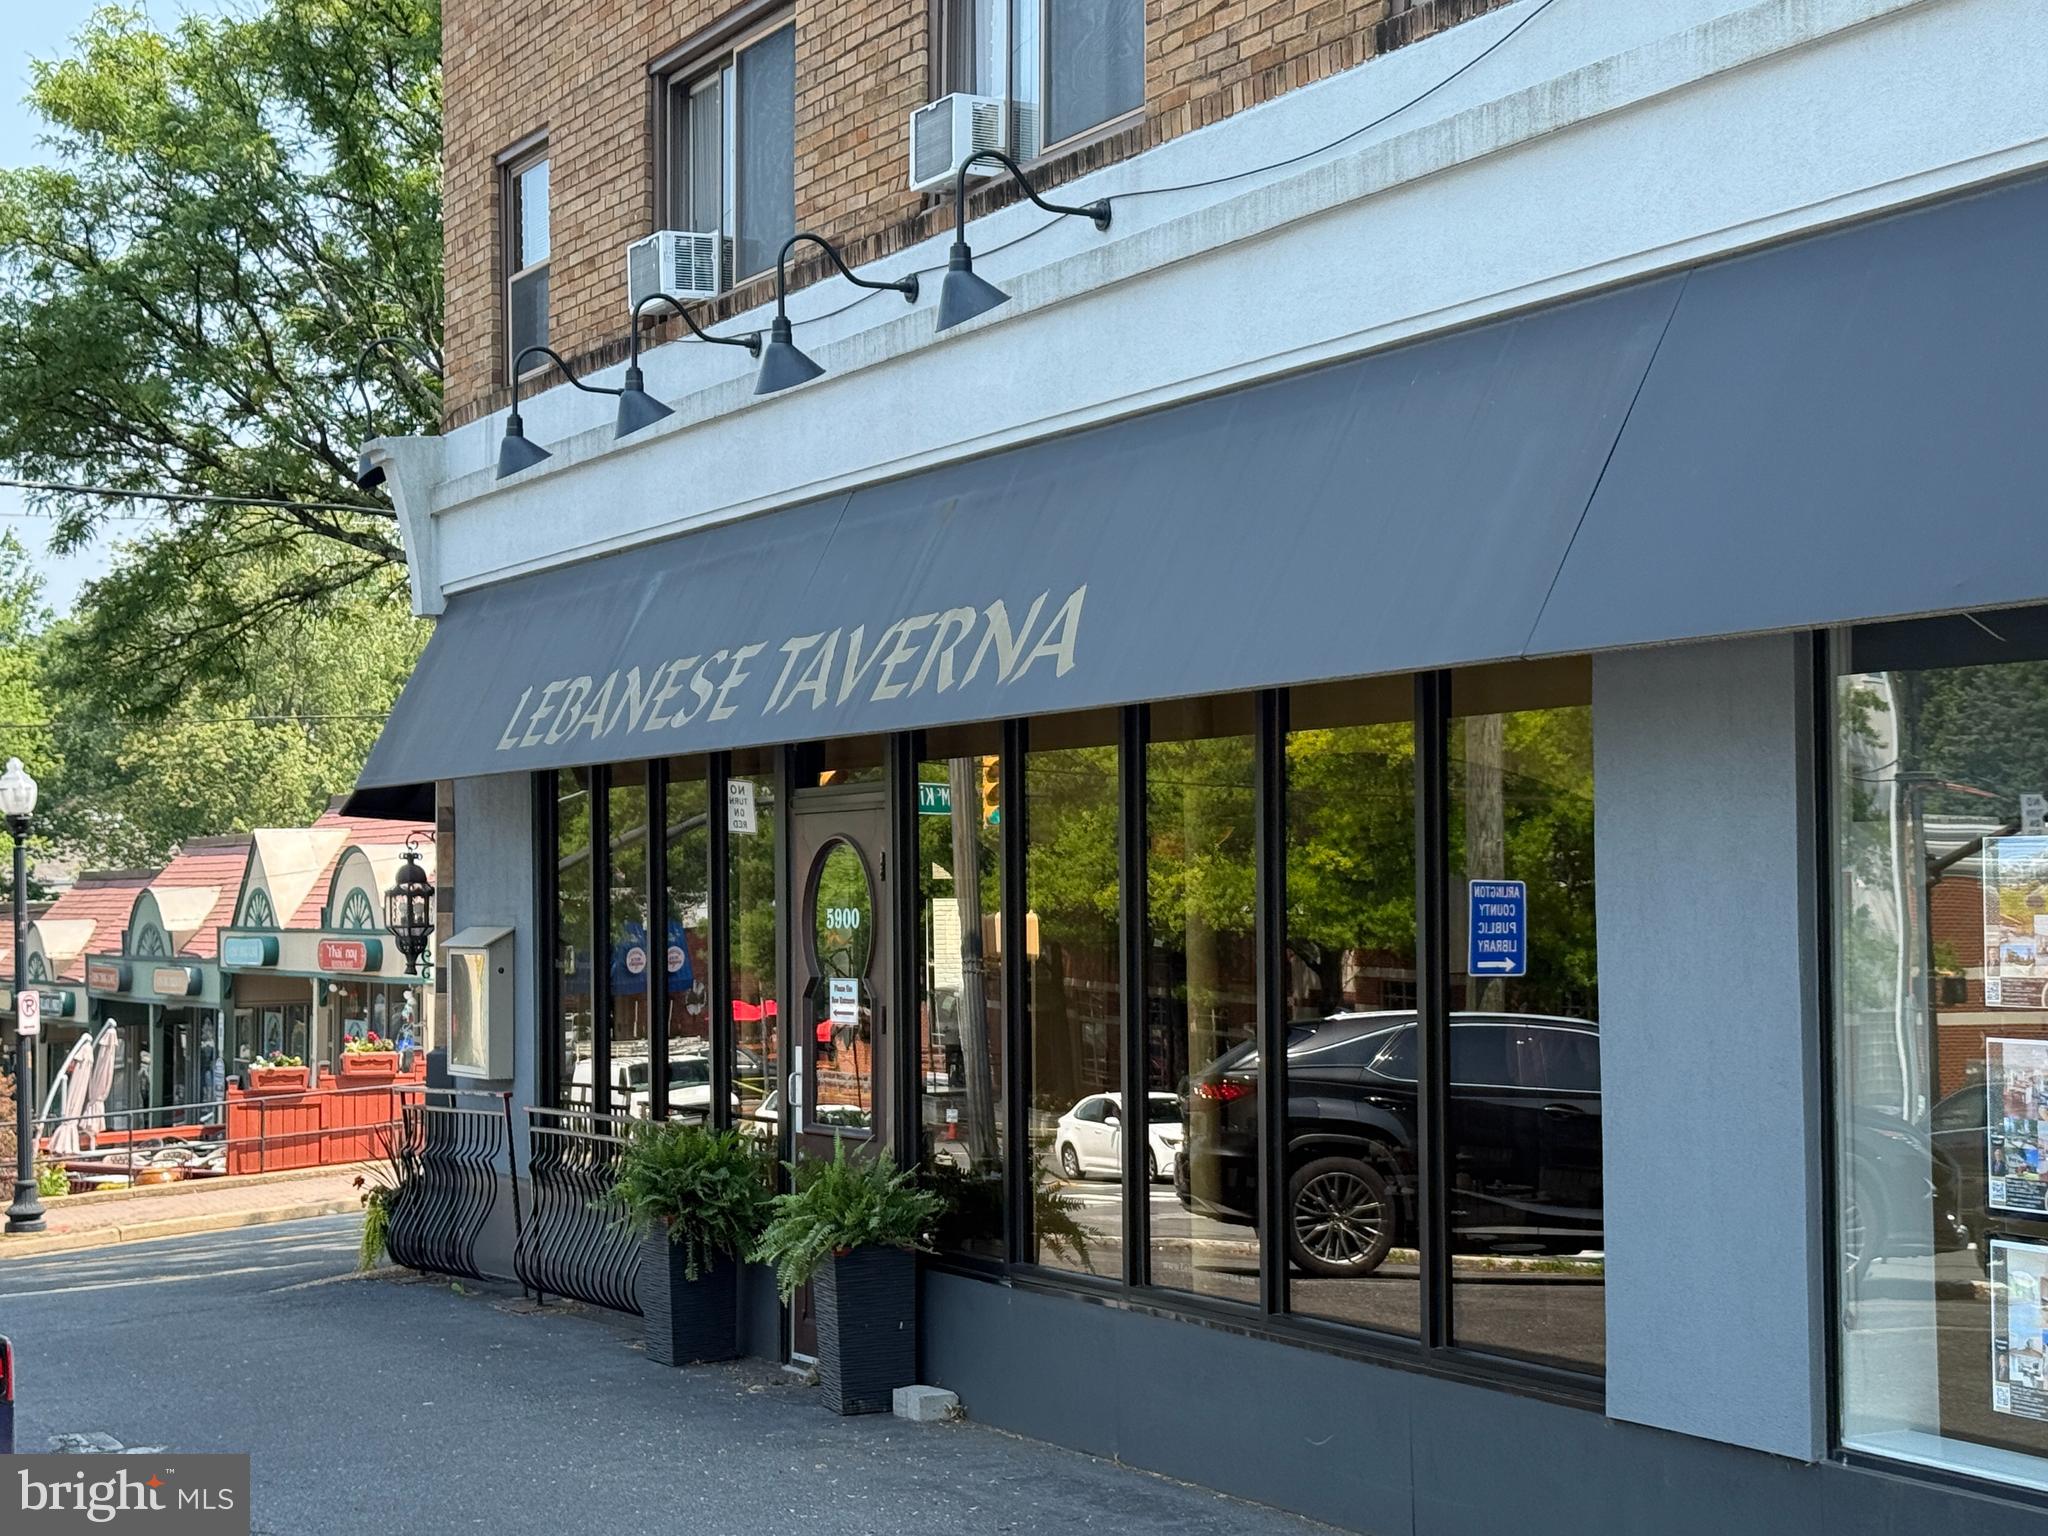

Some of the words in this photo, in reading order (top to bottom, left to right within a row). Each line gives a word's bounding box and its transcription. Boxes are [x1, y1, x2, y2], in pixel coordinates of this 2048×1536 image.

[496, 641, 768, 750] LEBANESE
[761, 583, 1087, 716] TAVERNA
[826, 907, 860, 929] 5900
